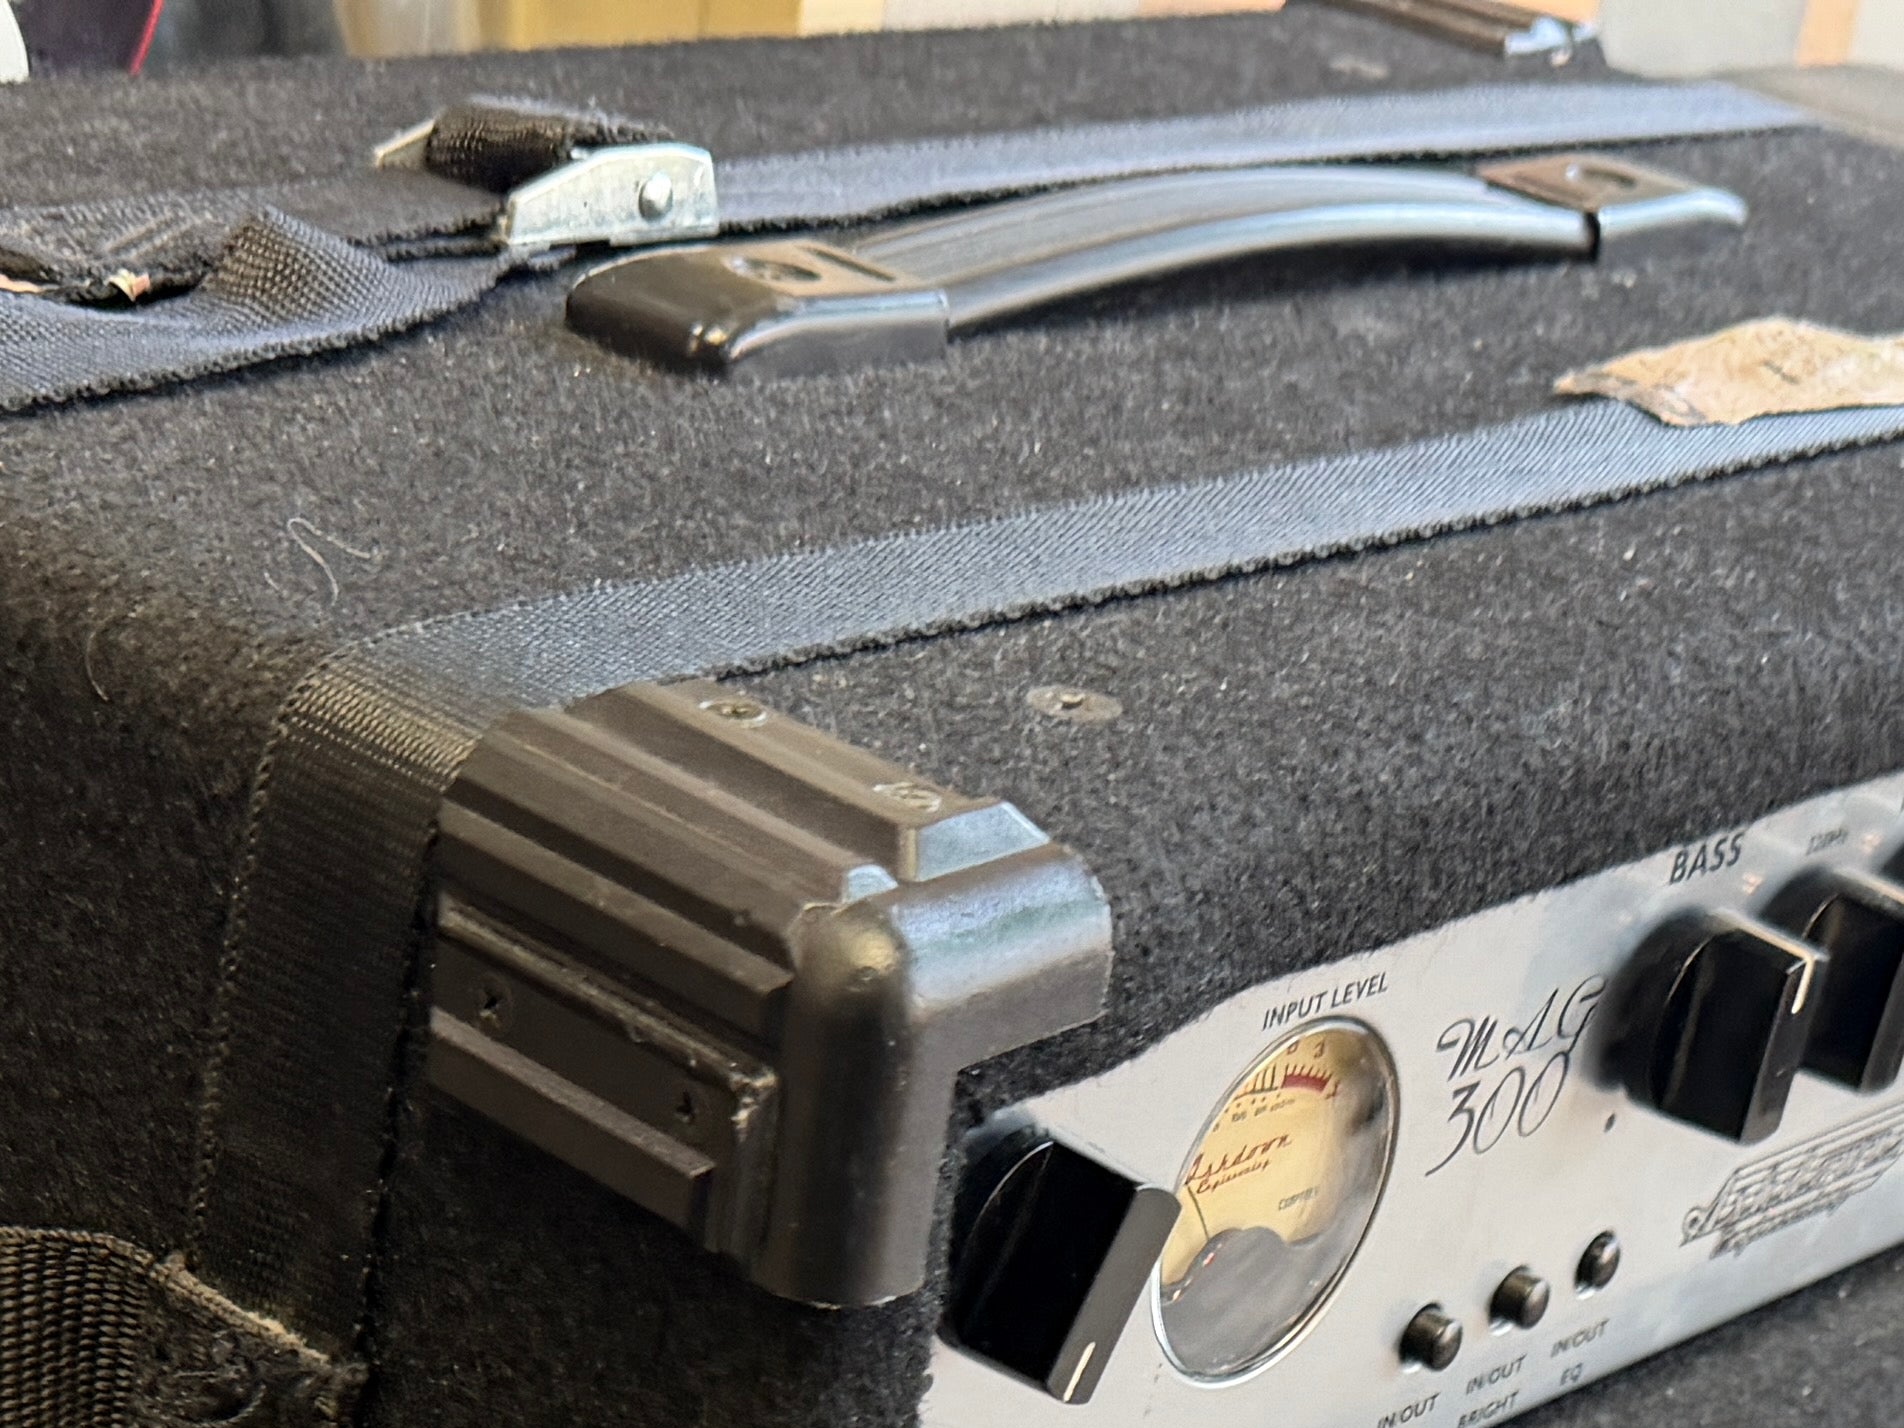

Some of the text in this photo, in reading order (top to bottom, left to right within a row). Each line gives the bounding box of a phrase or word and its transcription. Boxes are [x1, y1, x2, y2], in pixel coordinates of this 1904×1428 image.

[1668, 831, 1744, 886] BASS
[1262, 971, 1389, 1031] INPUT LEVEL
[1436, 974, 1609, 1082] MAG
[1424, 1050, 1571, 1177] 300
[1559, 1362, 1584, 1387] EQ
